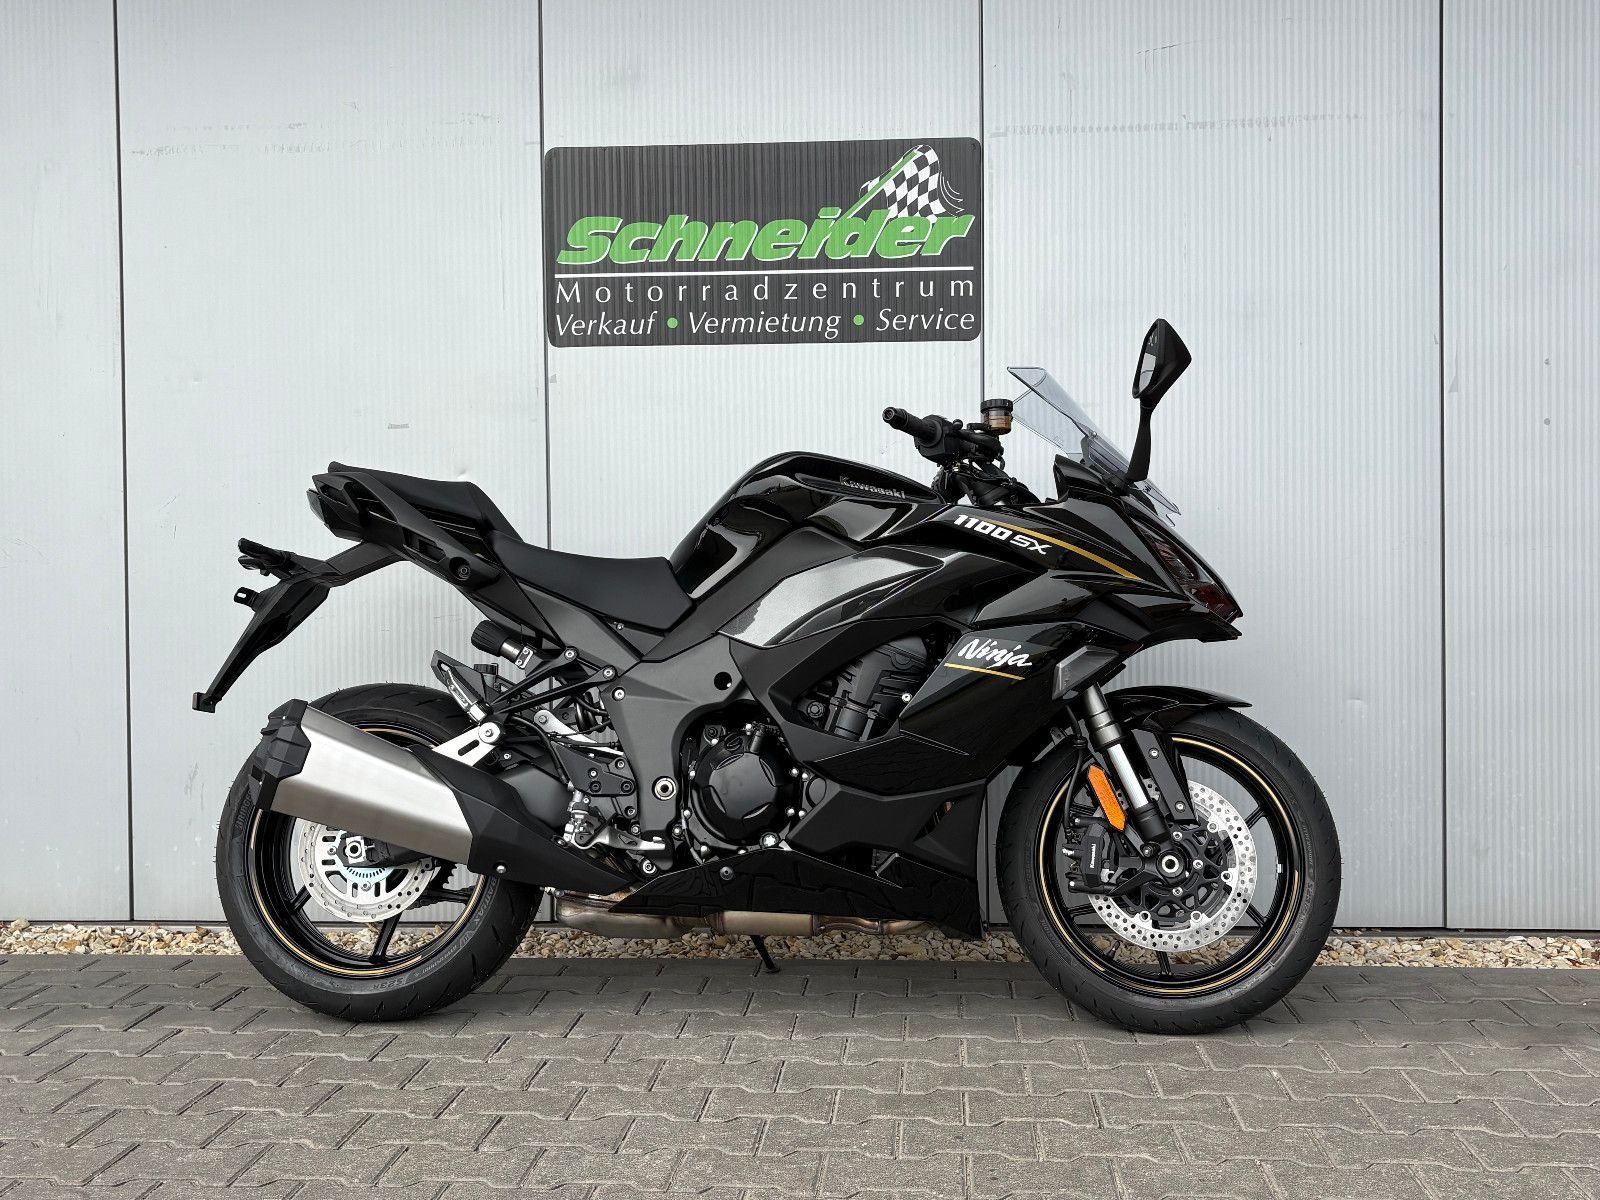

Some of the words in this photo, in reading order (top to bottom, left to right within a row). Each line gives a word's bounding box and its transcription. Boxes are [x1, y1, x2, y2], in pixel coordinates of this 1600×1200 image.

[556, 207, 976, 265] Schneider
[555, 276, 974, 304] Motorradzentrum
[555, 311, 658, 337] Verkauf
[689, 310, 842, 340] Vermietung
[876, 308, 975, 332] Service
[839, 475, 906, 499] Kawasaki
[957, 638, 1033, 670] Ninja
